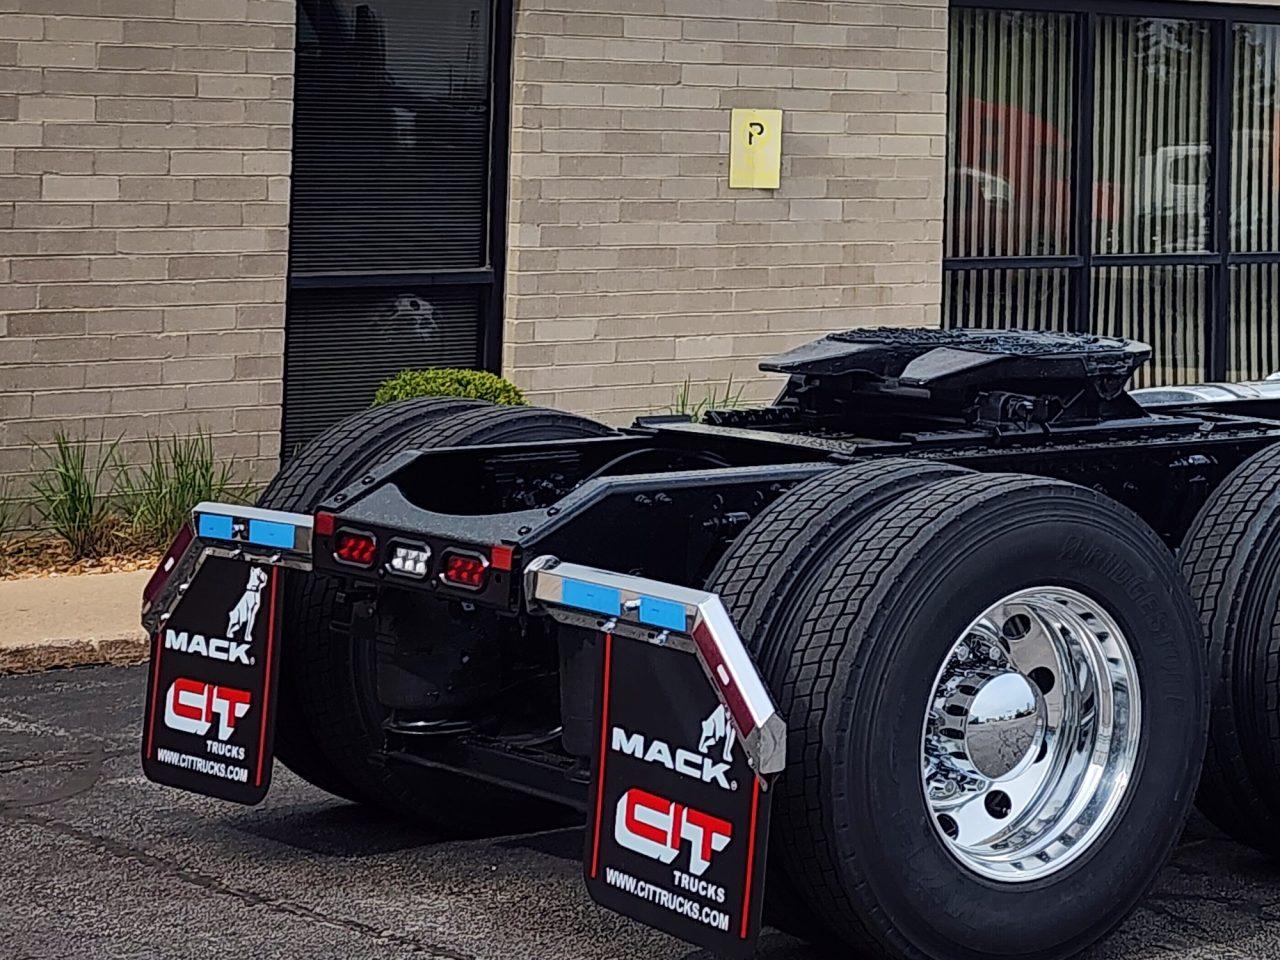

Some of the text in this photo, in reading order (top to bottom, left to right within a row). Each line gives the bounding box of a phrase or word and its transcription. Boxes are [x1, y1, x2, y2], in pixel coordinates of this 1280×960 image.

[748, 122, 764, 146] P
[164, 628, 252, 665] MACK
[169, 677, 252, 733] CIT
[157, 747, 249, 783] WWW.CITTRUCKS.COM
[206, 739, 246, 760] TRUCKS
[611, 726, 732, 790] MACK
[619, 788, 733, 869] CIT
[605, 866, 729, 932] WWW.CITTRUCKS.COM
[673, 869, 725, 903] TRUCKS
